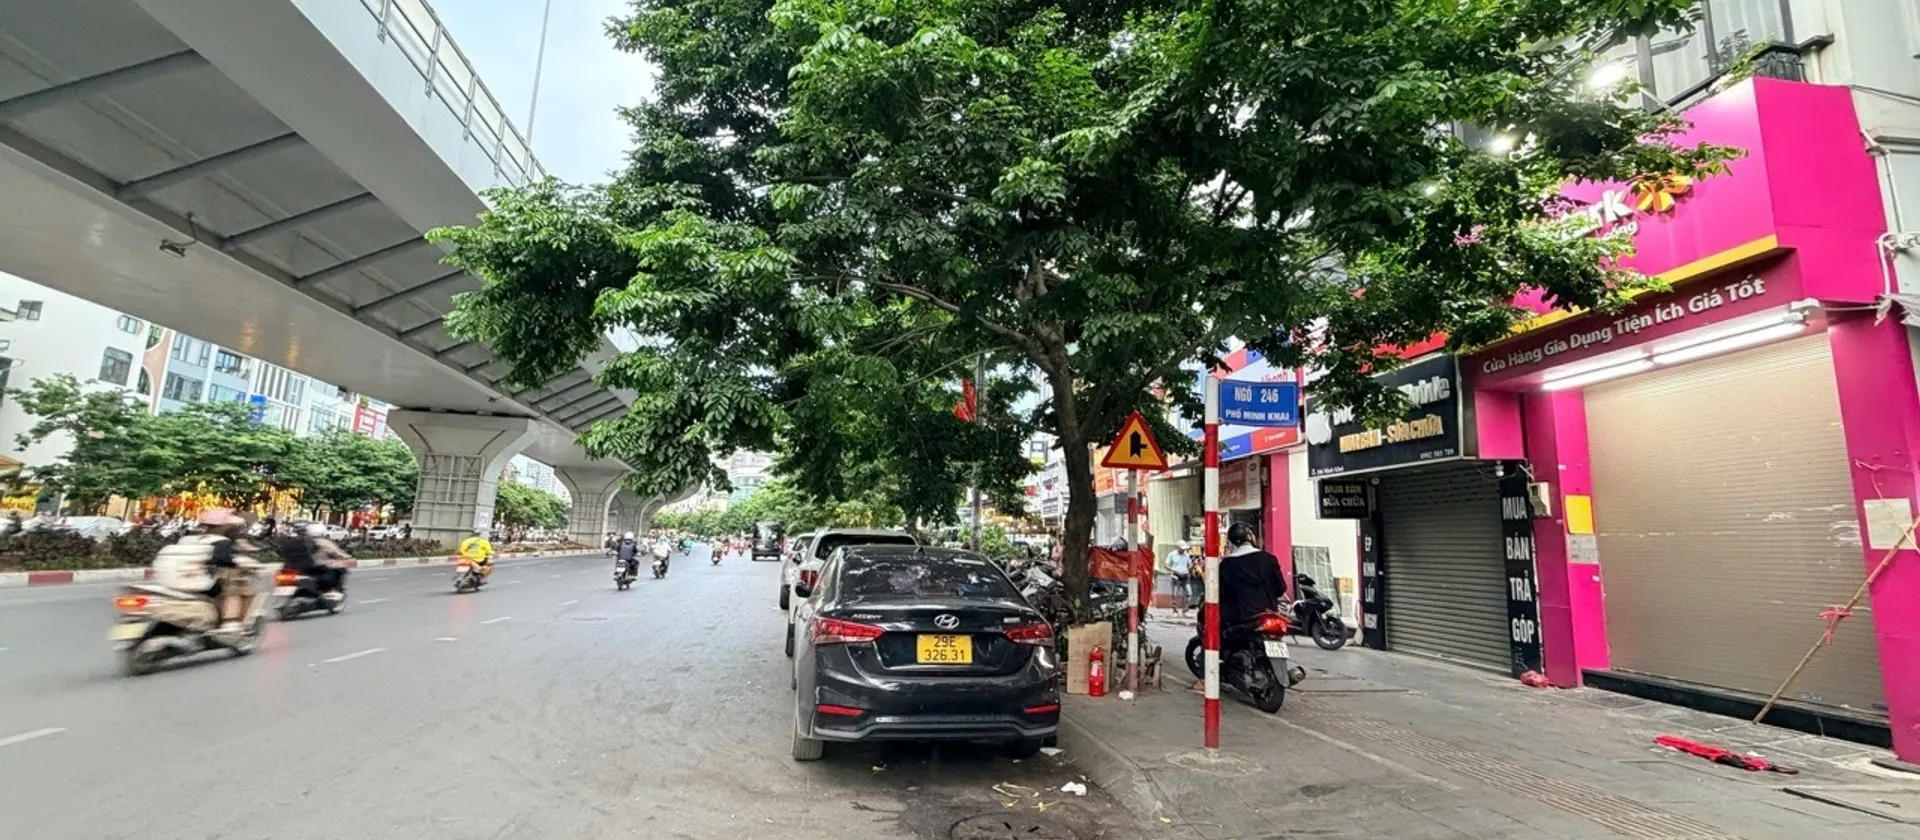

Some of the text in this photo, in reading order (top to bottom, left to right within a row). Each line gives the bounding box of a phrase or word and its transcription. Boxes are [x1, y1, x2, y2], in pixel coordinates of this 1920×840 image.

[1483, 275, 1767, 374] Cửa Hàng Gia Dụng Tiện Ích Giá Tốt
[1260, 387, 1280, 404] 246
[1243, 410, 1266, 421] MINH
[1267, 411, 1290, 421] KHAI
[1502, 496, 1528, 520] MUA
[1505, 532, 1531, 560] BÁN
[1509, 569, 1533, 602] TRẢ
[850, 612, 882, 620] ACCENT
[1511, 613, 1536, 644] GÓP
[933, 635, 957, 648] 29E
[924, 649, 965, 662] 326.31
